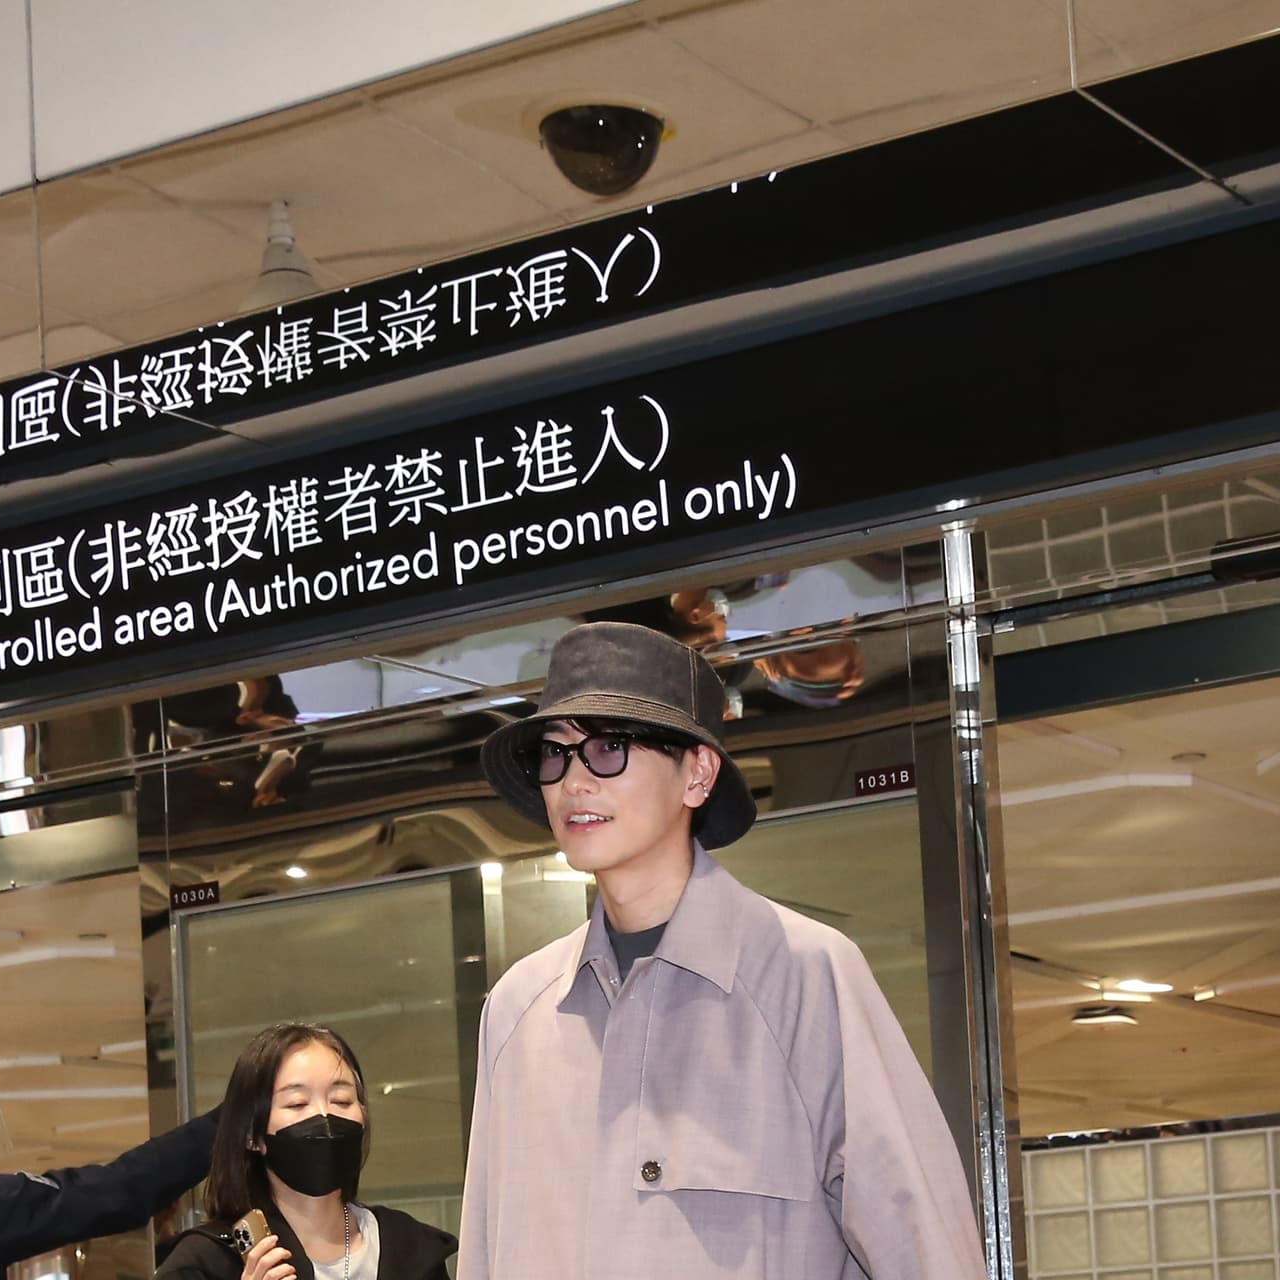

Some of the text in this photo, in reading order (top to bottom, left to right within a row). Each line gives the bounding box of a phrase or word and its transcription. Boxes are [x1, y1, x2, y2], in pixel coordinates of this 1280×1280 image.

[114, 599, 195, 644] area
[205, 530, 439, 633] (Authorized
[453, 478, 670, 586] personnel
[684, 453, 797, 521] only)
[858, 770, 910, 790] 1031B
[173, 887, 215, 904] 1030A
